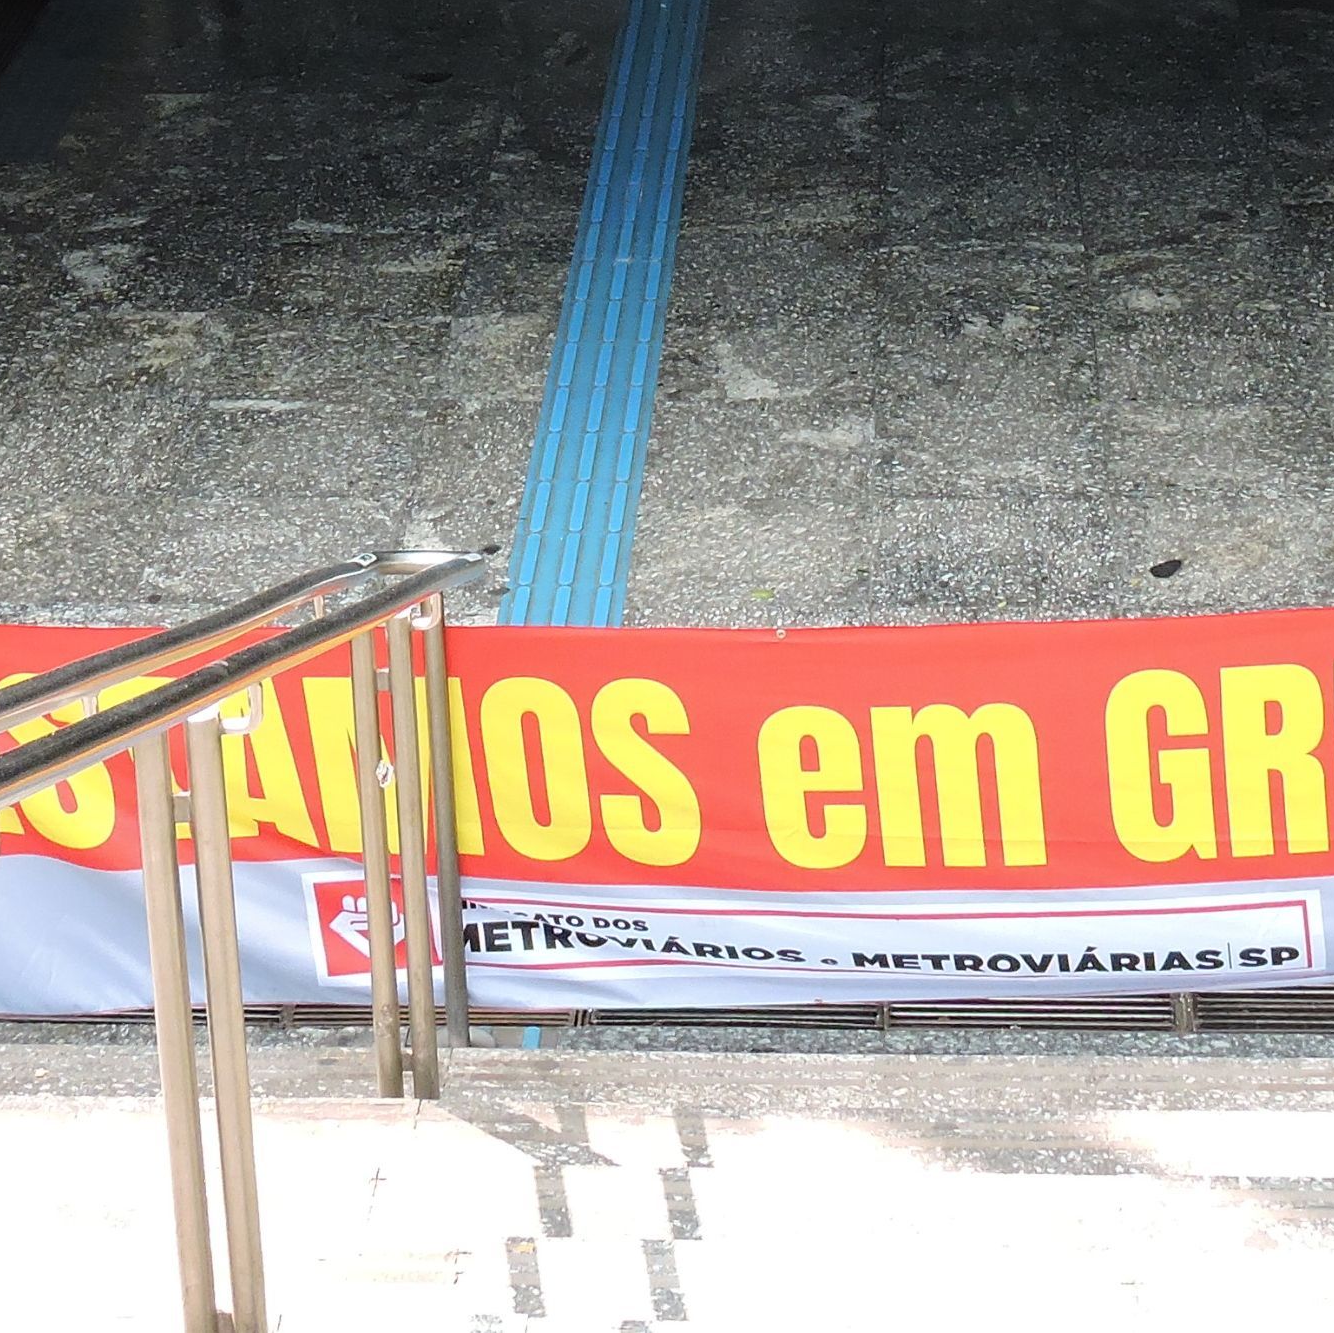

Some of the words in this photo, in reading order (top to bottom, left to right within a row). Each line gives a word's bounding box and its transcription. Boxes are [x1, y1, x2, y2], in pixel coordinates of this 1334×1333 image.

[756, 702, 1048, 870] em
[592, 916, 649, 931] DOS
[852, 946, 1225, 973] METROVIÁRIAS
